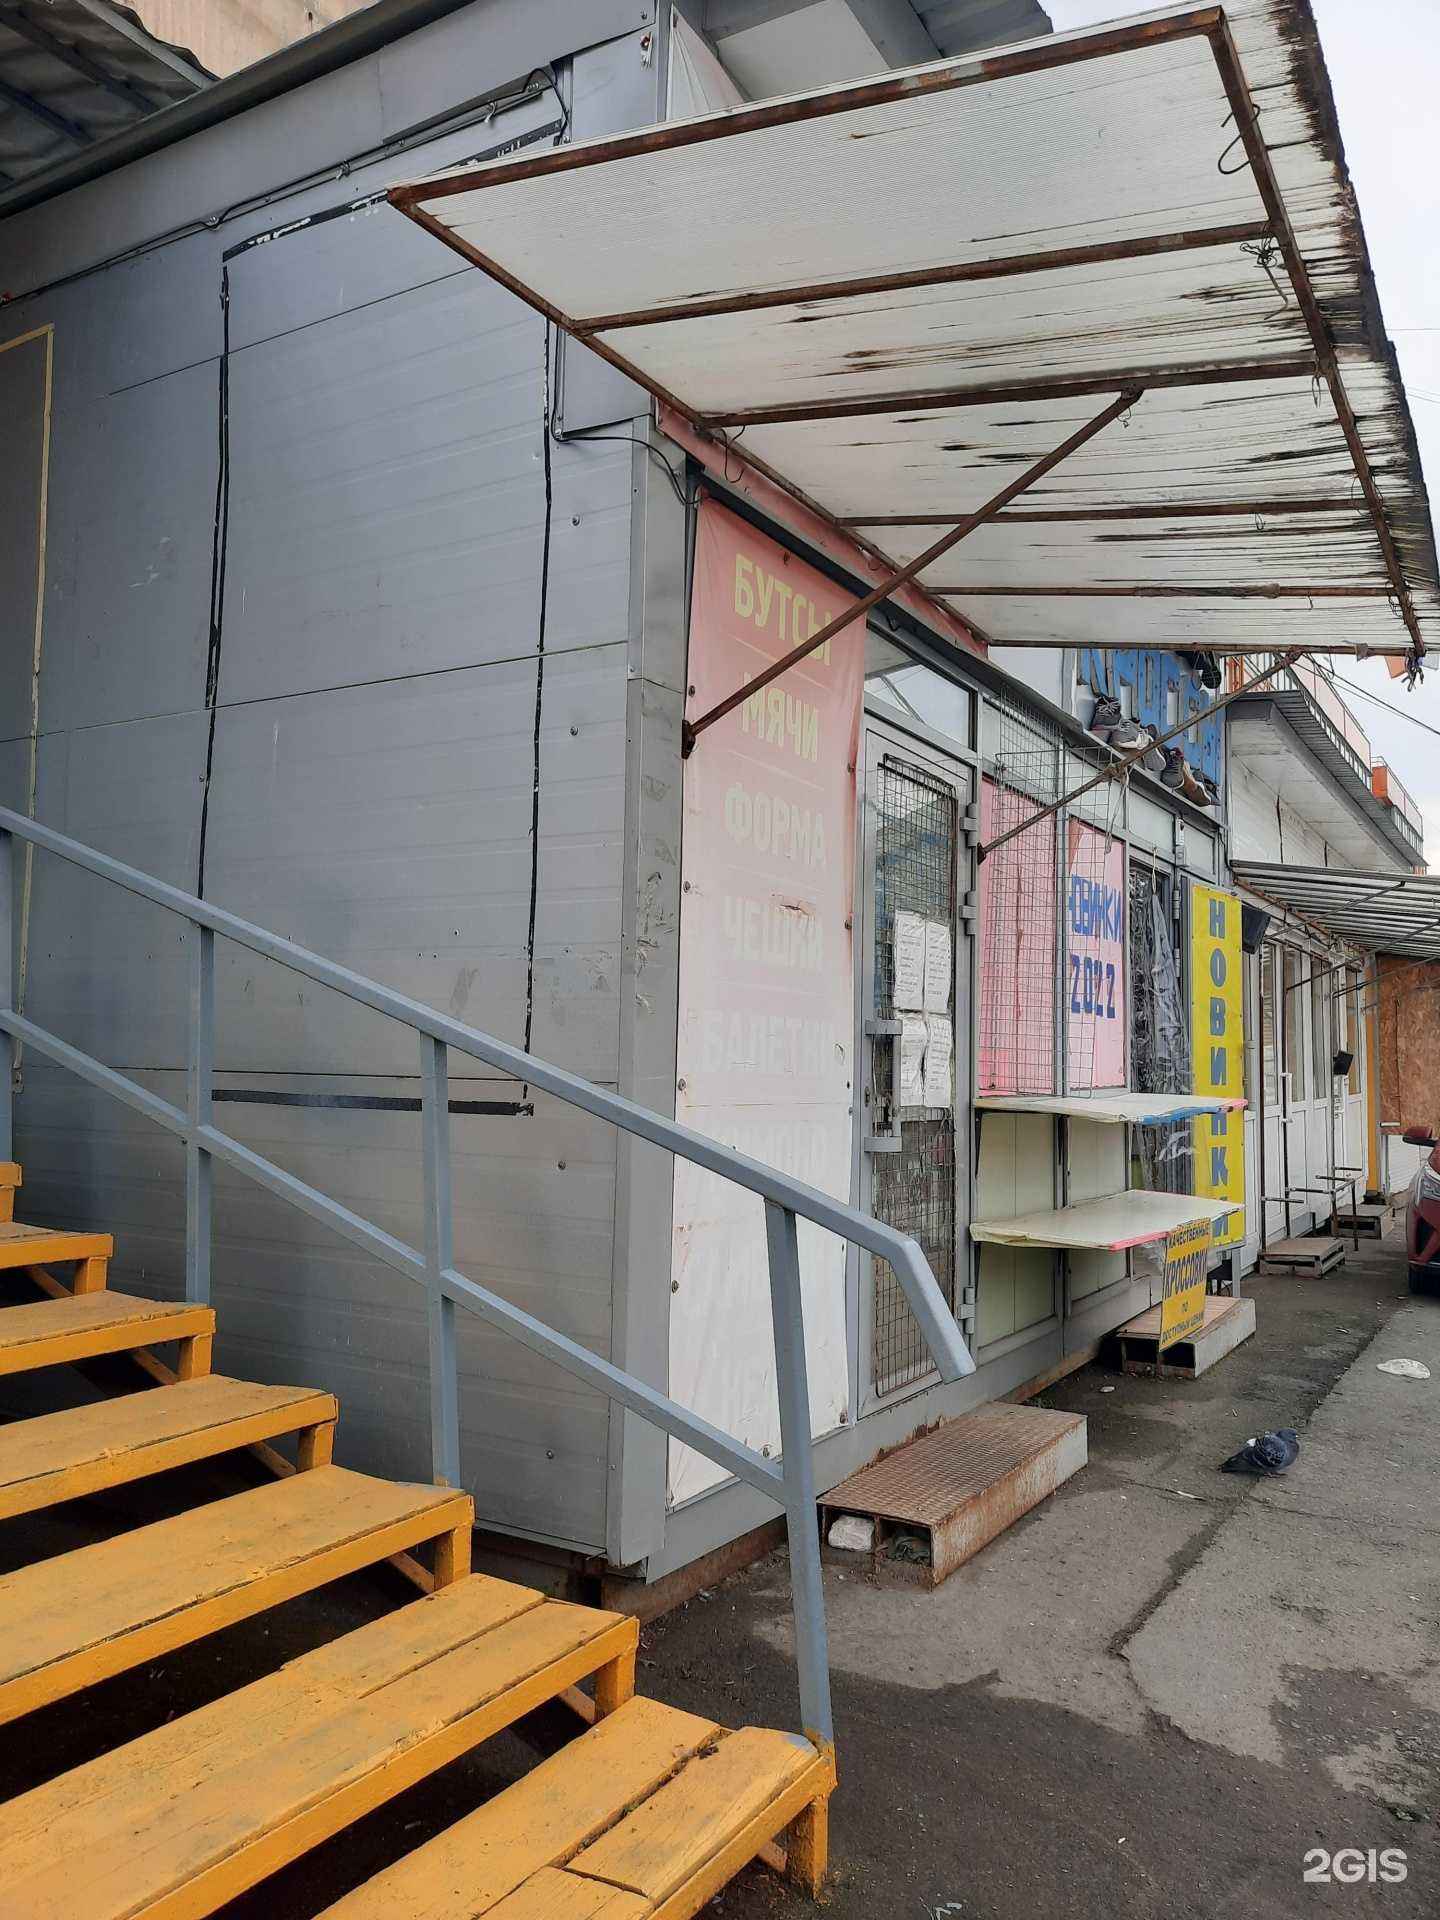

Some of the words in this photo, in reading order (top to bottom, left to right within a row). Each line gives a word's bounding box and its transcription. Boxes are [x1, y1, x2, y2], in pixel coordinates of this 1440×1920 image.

[734, 553, 832, 666] БУТСЫ
[742, 672, 818, 761] МЯЧИ
[724, 782, 827, 872] ФОРМА
[721, 895, 825, 973] ЧЕШКИ
[1070, 953, 1116, 1019] 2022
[1164, 1247, 1208, 1301] КРОССОВКИ
